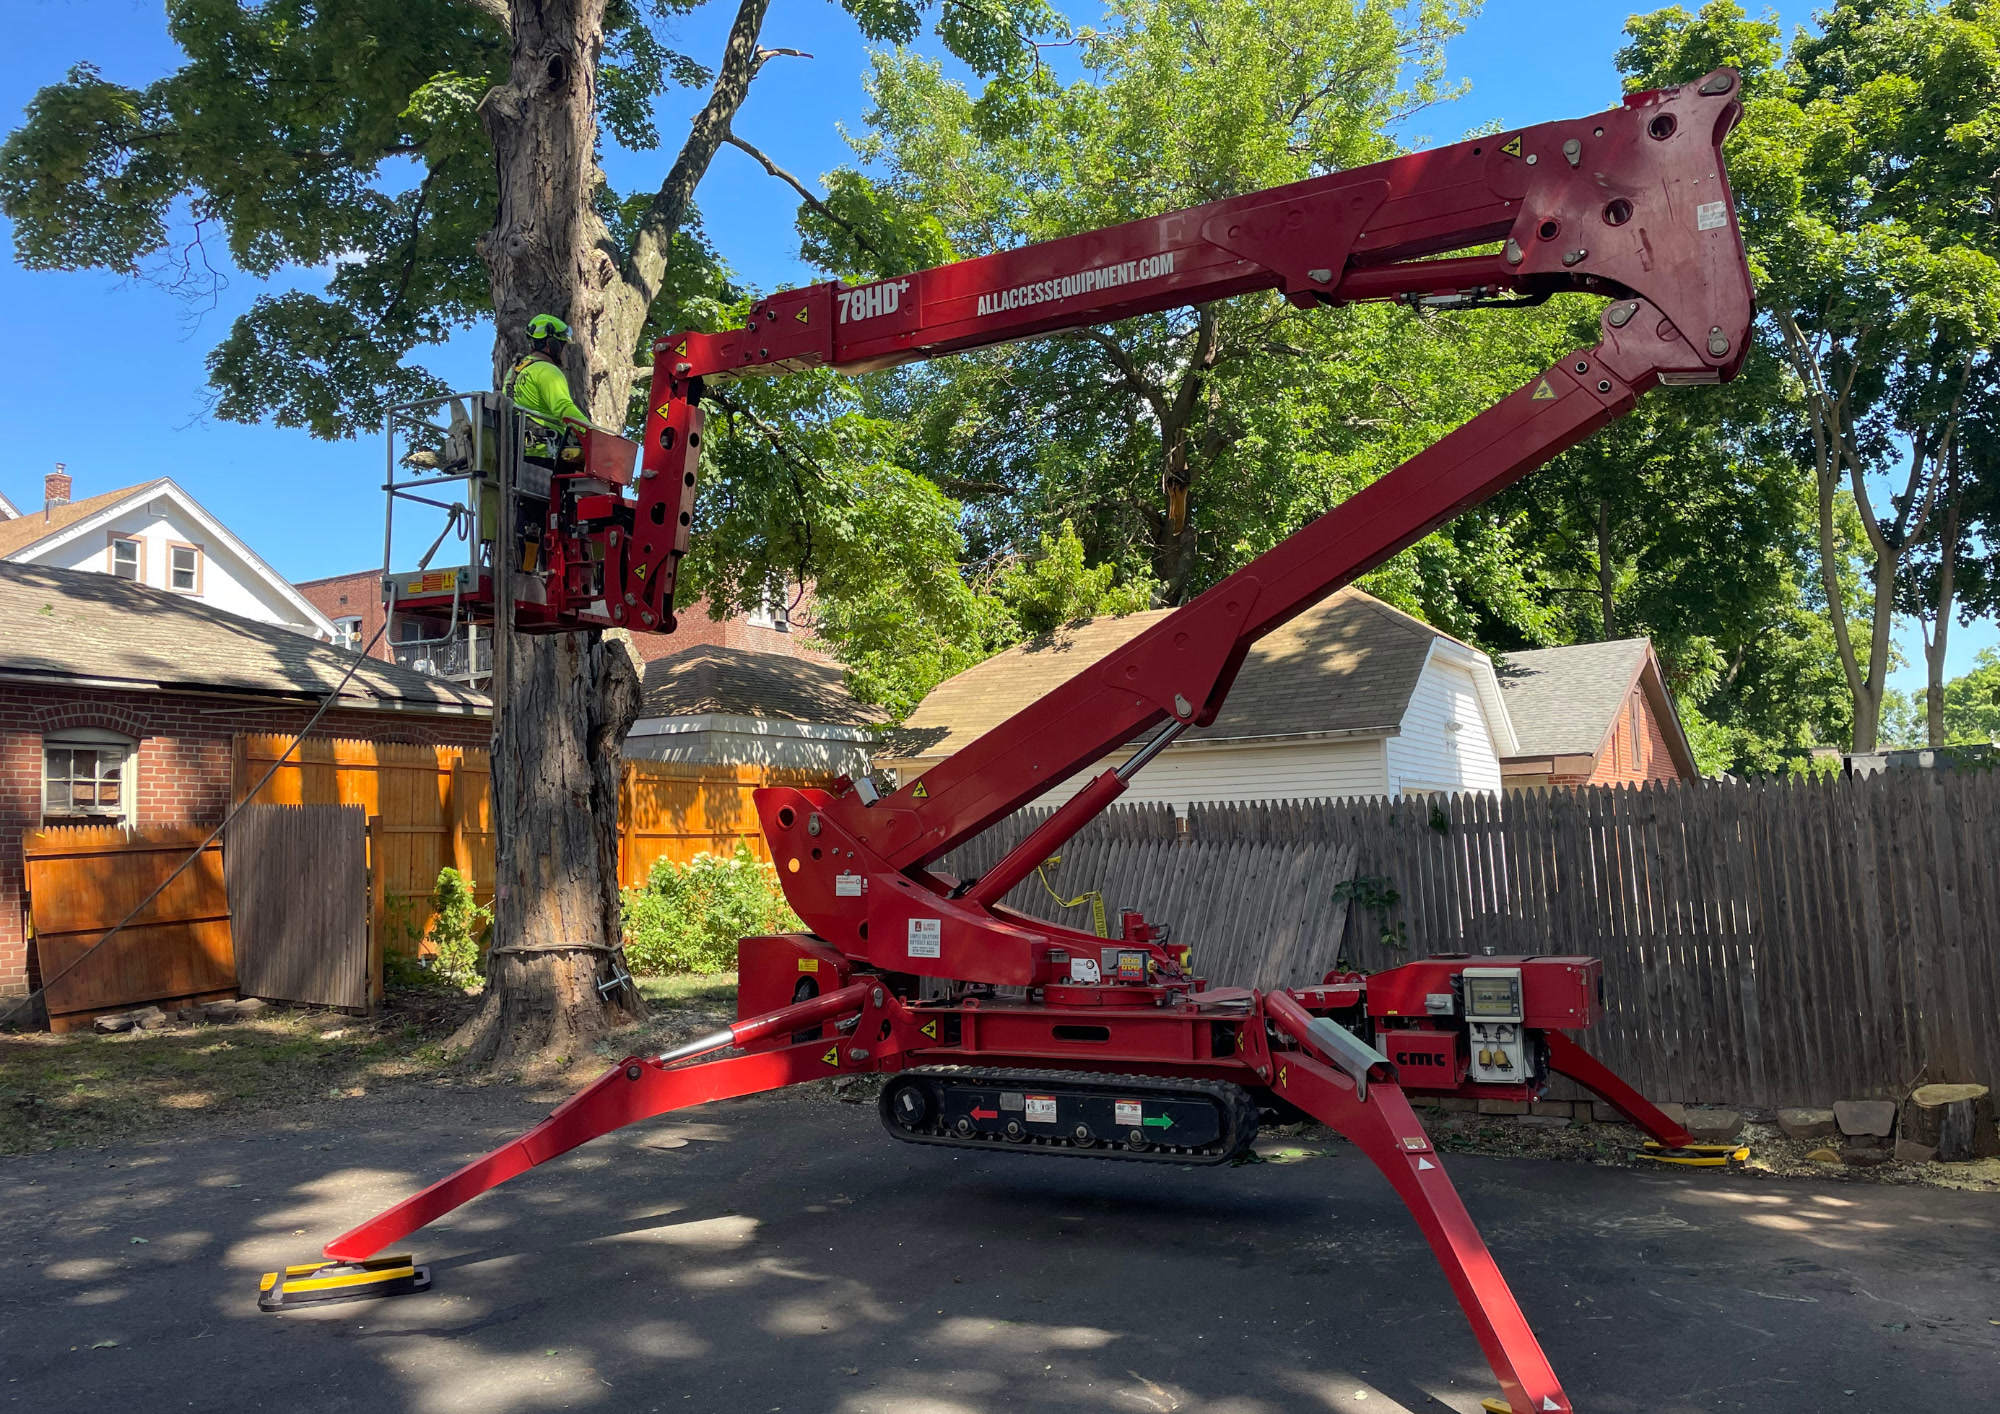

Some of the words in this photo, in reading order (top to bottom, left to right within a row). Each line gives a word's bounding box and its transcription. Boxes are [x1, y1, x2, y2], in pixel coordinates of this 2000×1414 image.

[837, 279, 910, 324] 78HD+
[977, 253, 1174, 316] ALLACCESSEQUIPMENT.COM
[1396, 1052, 1446, 1067] cmc
